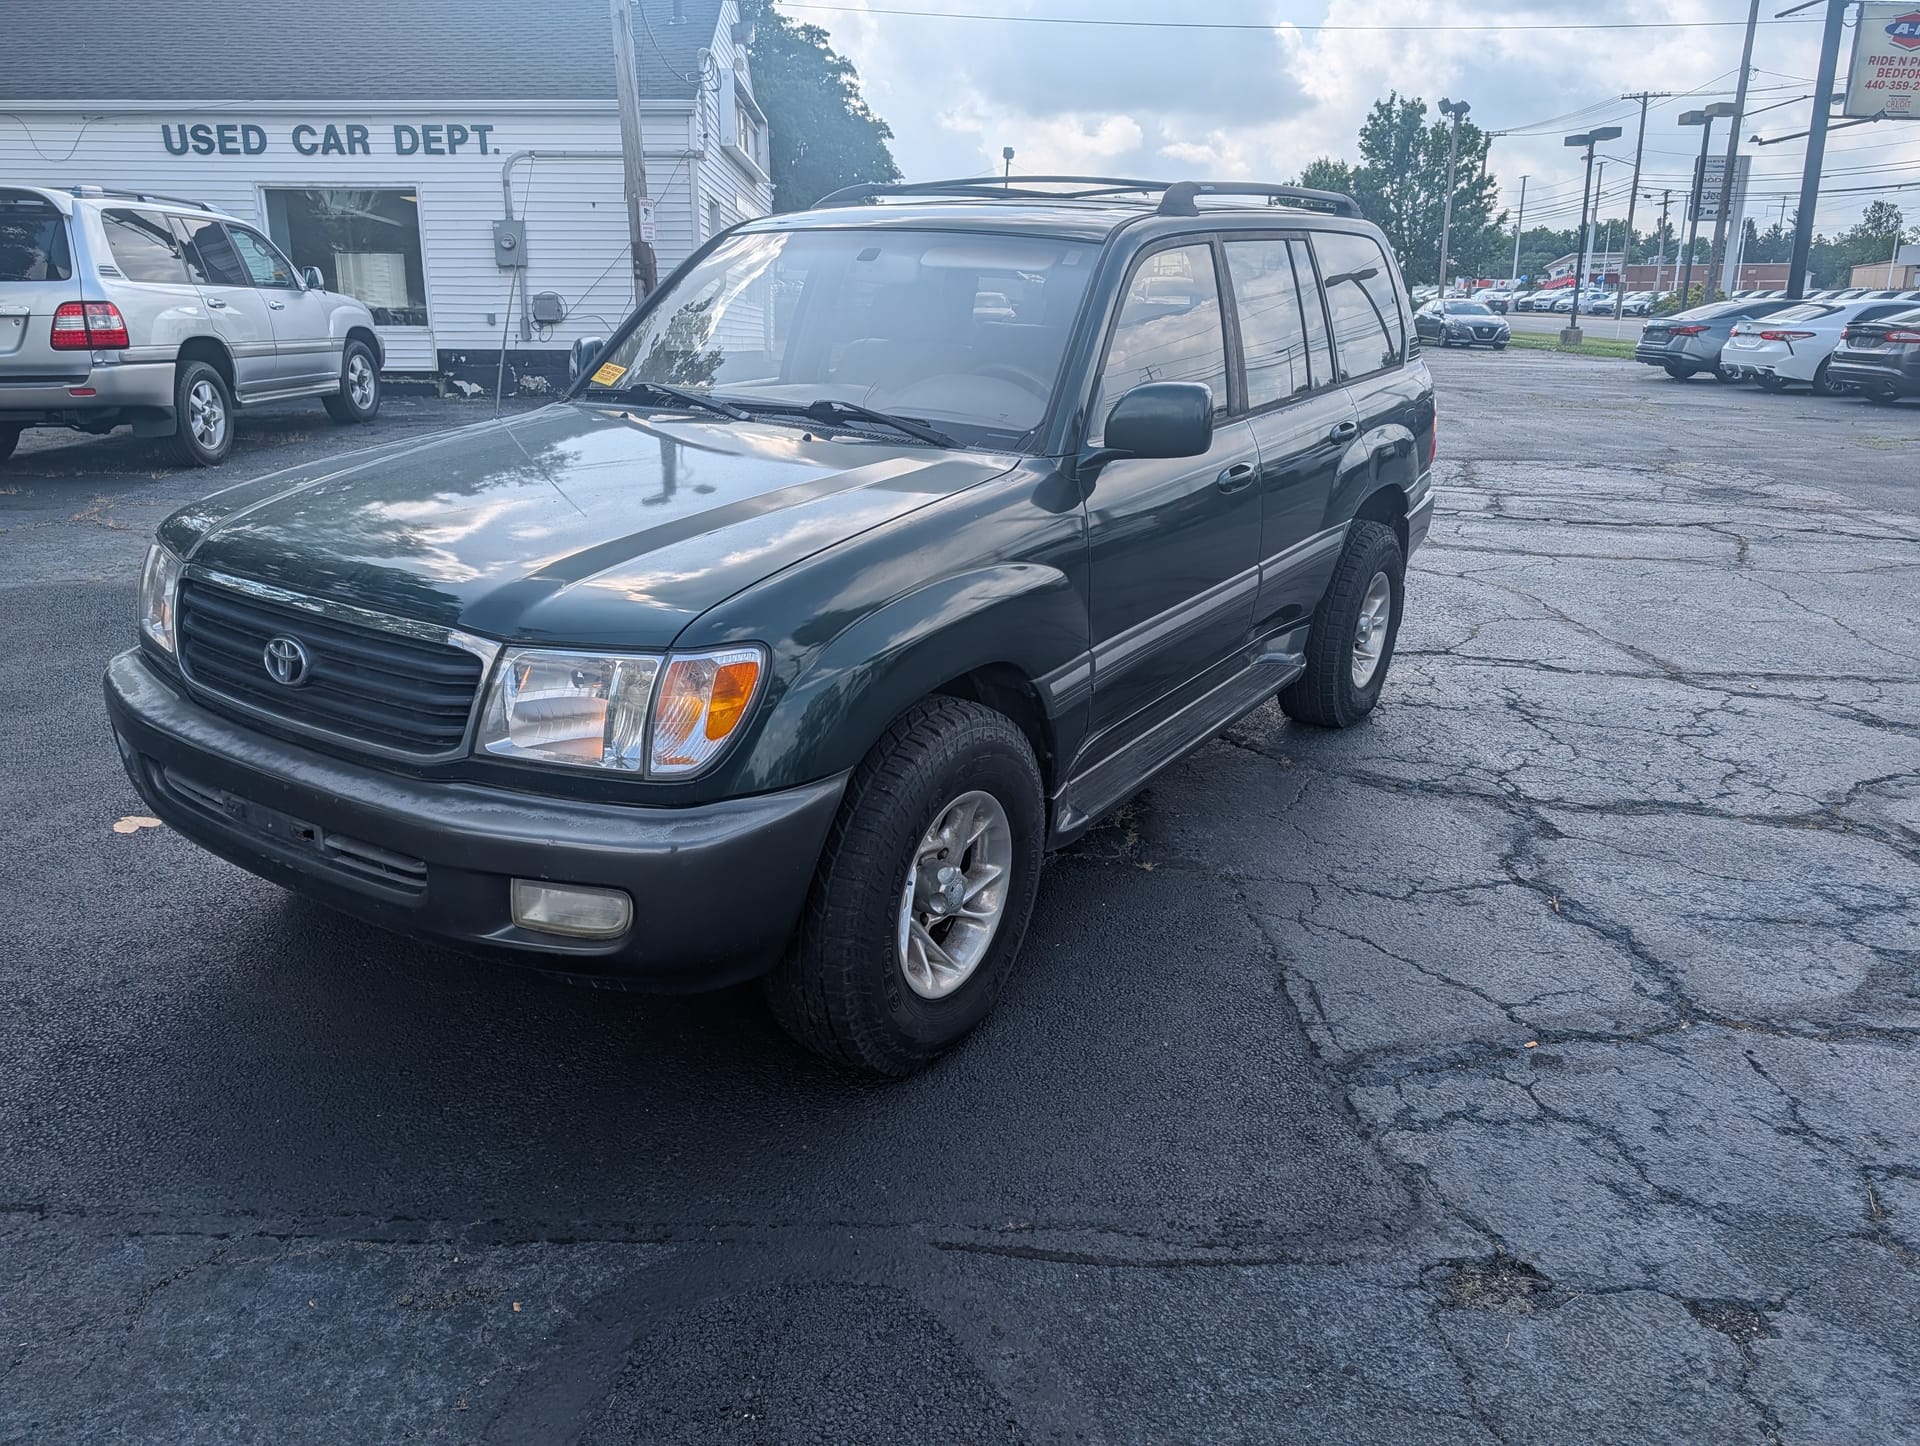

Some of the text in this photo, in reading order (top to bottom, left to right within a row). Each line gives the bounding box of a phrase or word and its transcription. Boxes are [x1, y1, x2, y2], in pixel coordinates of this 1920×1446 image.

[1868, 56, 1920, 67] RIDE N P
[1864, 80, 1920, 91] 440-359-2
[161, 124, 500, 156] USED CAR DEPT.
